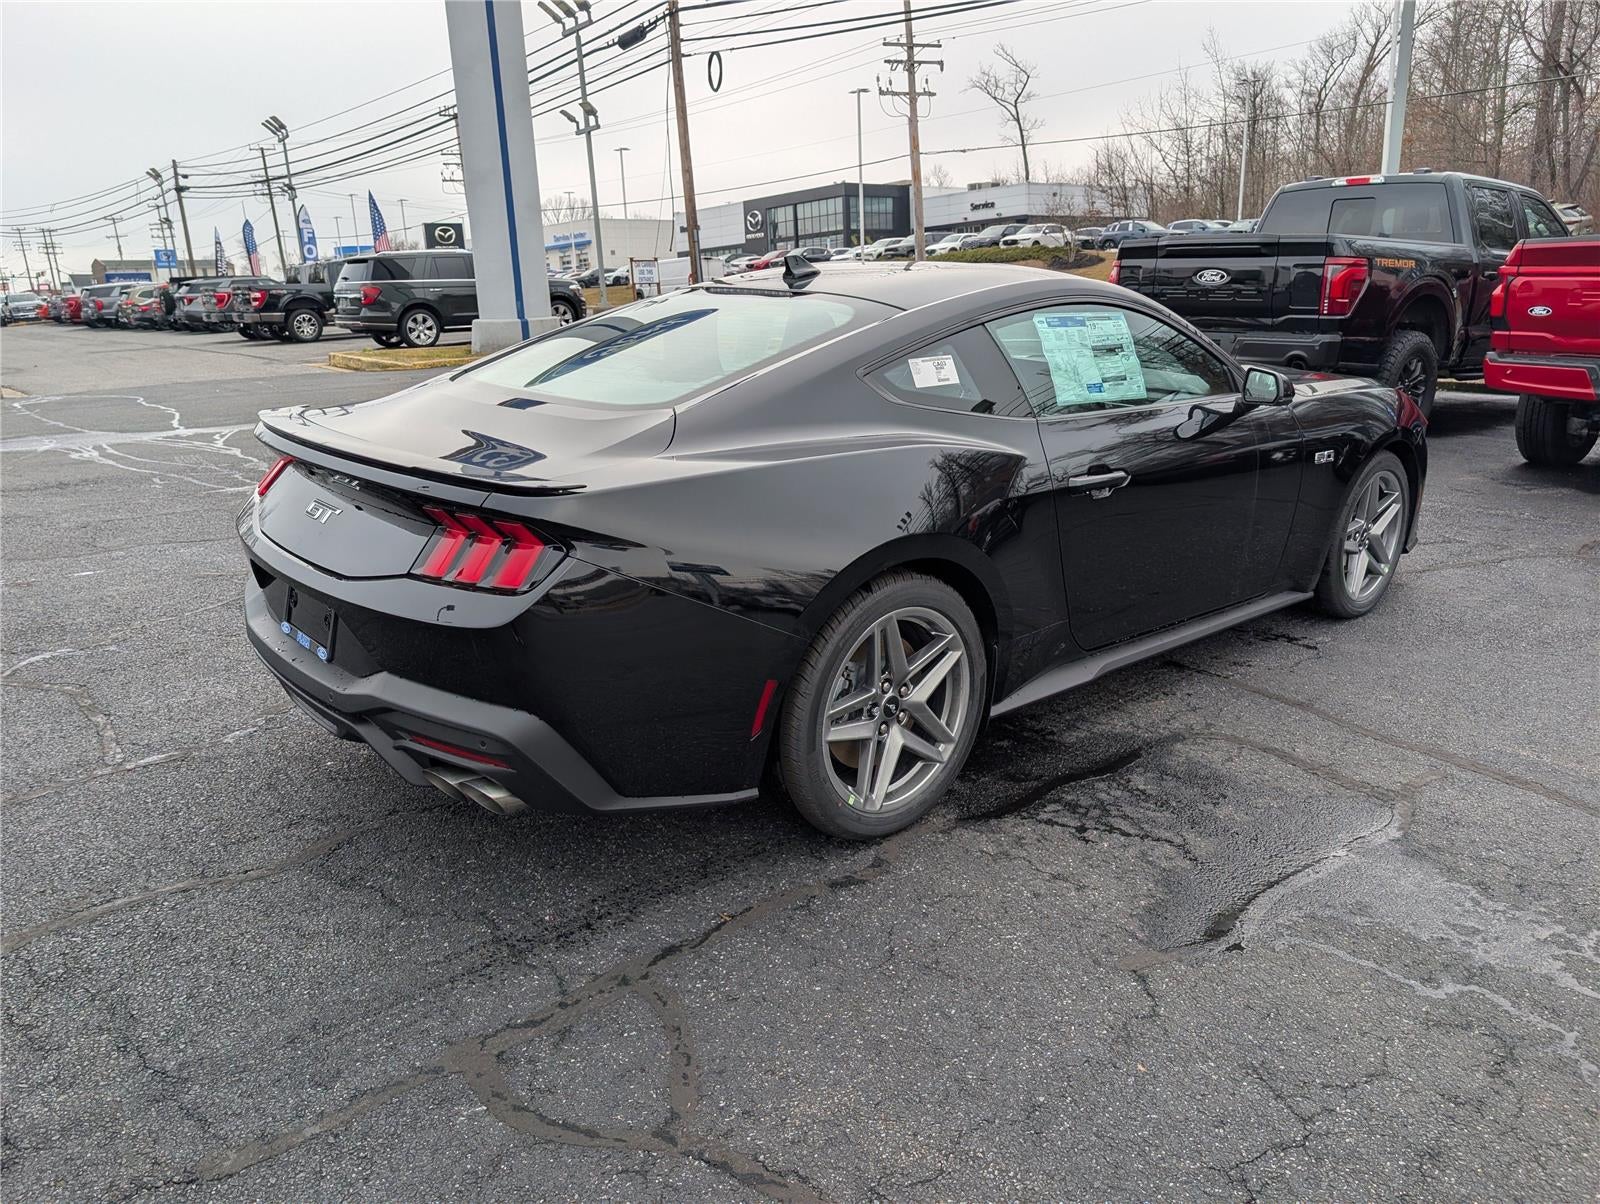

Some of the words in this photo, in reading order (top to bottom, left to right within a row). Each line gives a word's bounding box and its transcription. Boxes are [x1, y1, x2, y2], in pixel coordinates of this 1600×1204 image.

[970, 200, 995, 211] Service
[1375, 257, 1416, 268] TREMOR
[1200, 270, 1223, 282] Ford
[1530, 307, 1549, 315] Ford
[305, 498, 344, 525] GT
